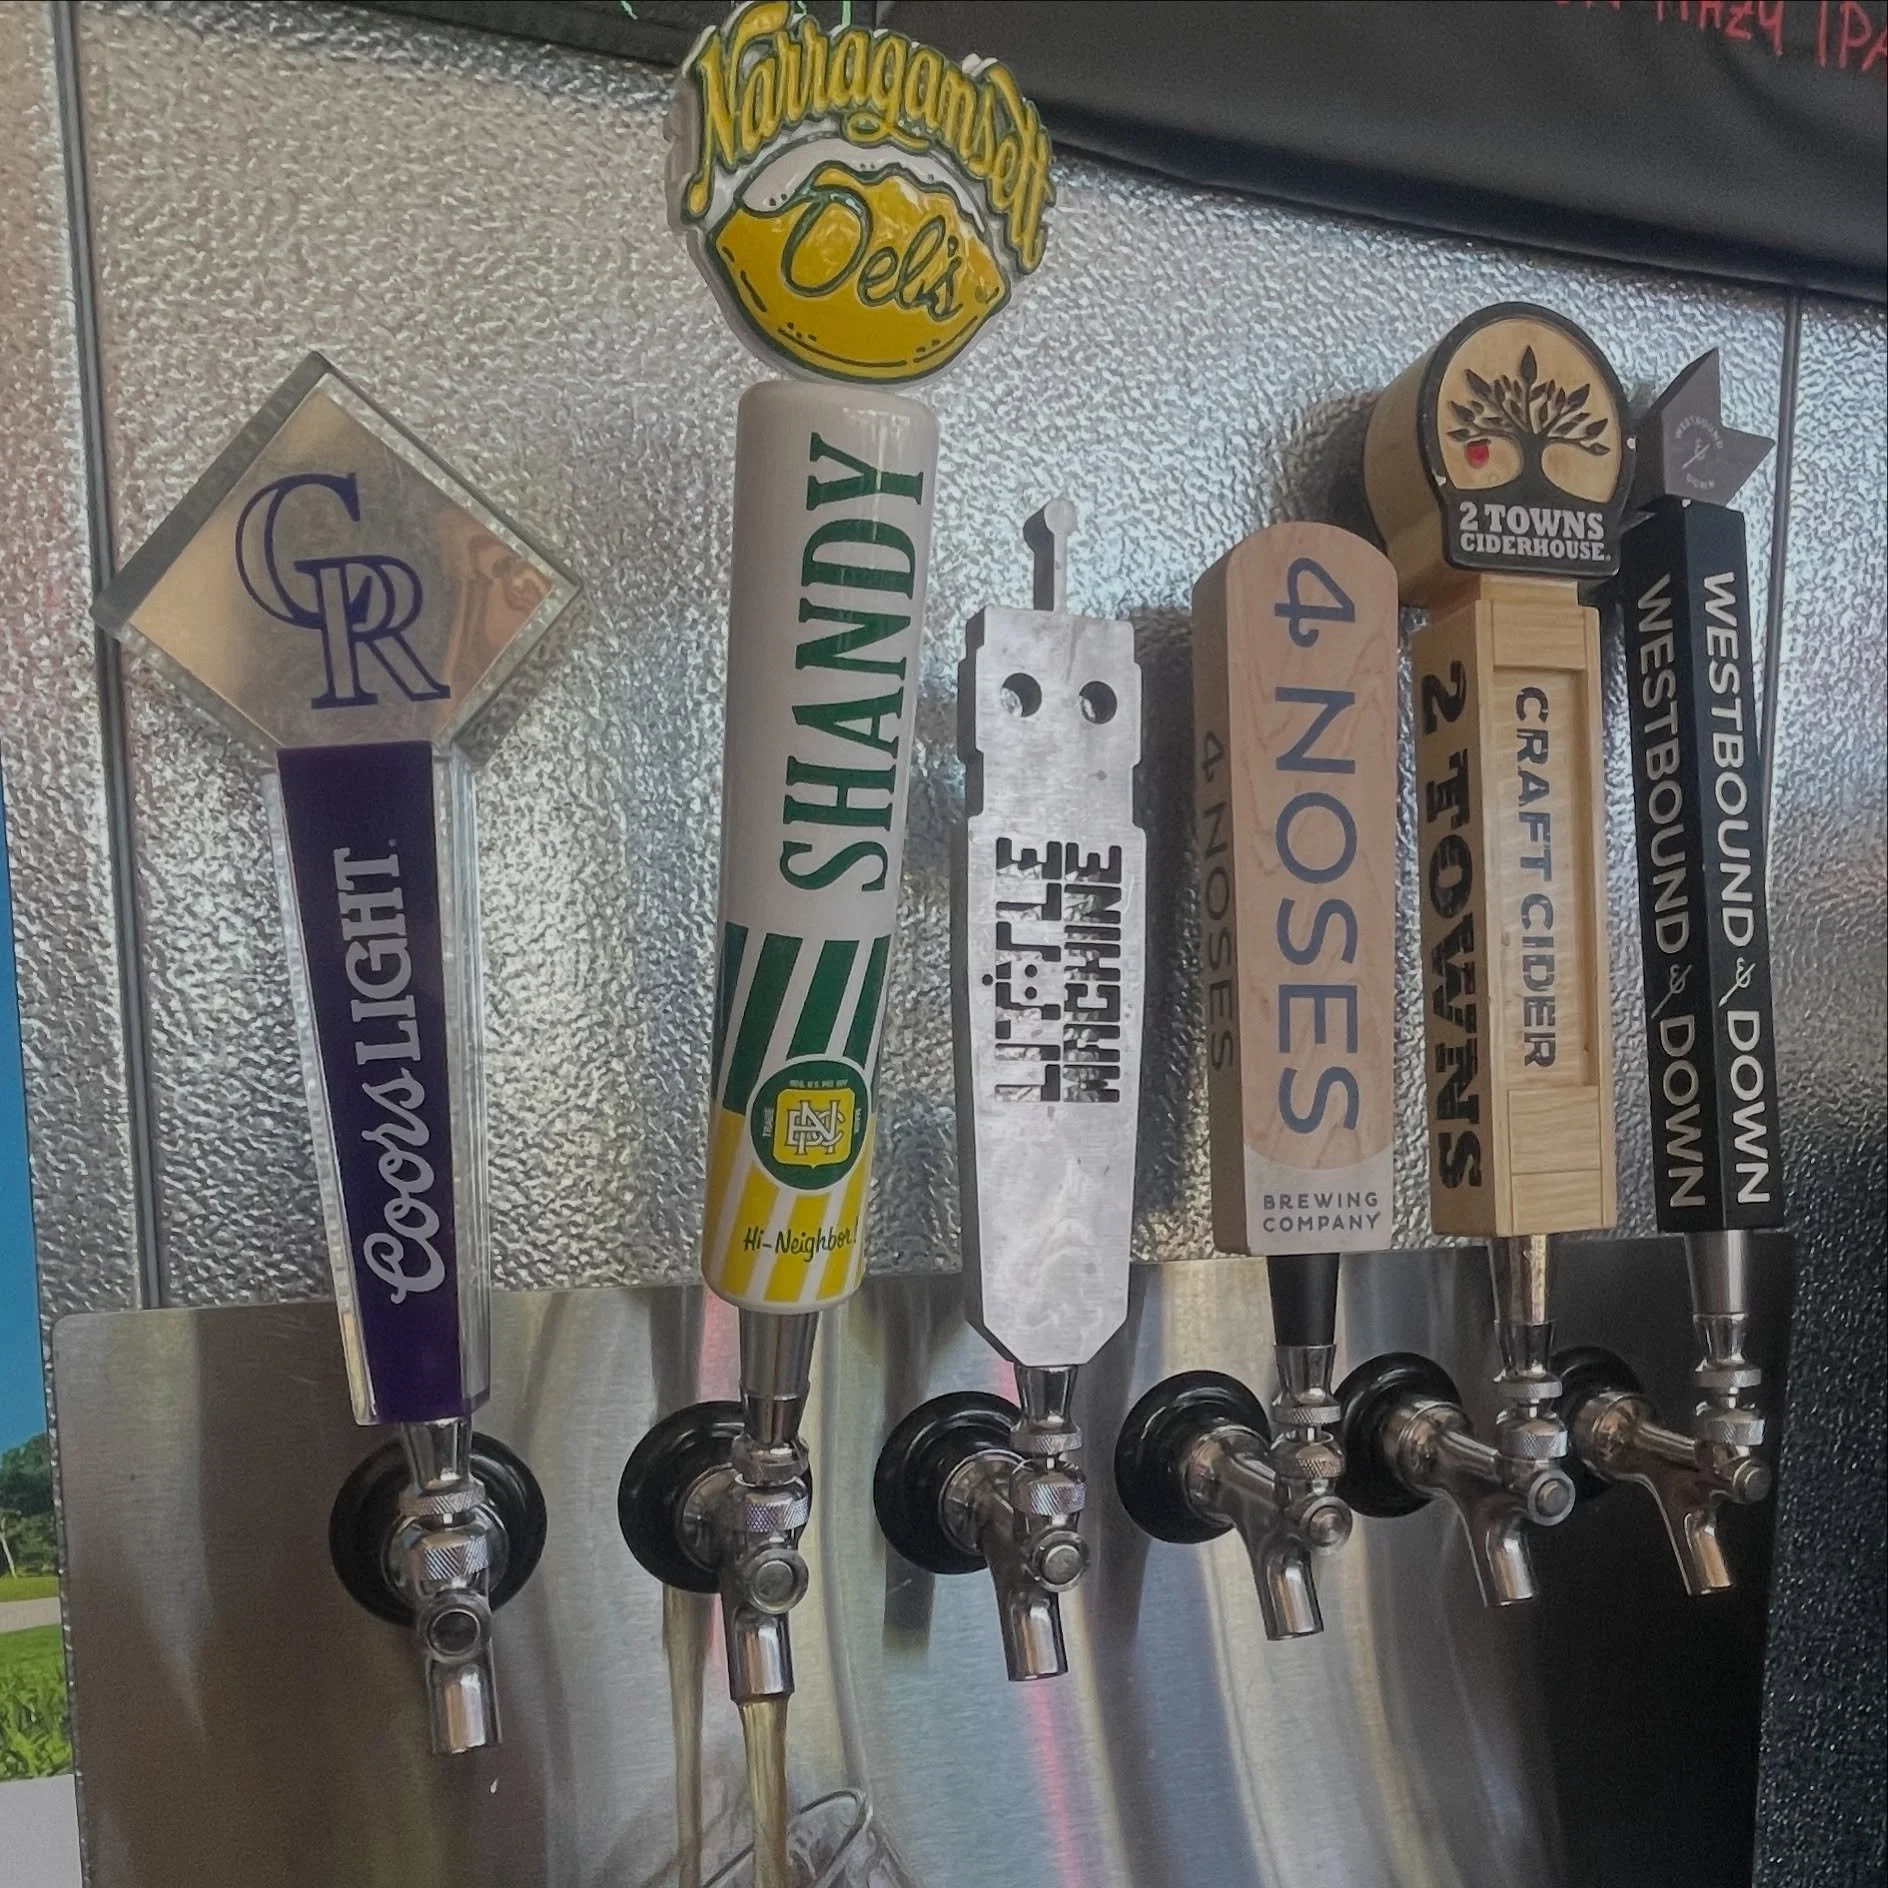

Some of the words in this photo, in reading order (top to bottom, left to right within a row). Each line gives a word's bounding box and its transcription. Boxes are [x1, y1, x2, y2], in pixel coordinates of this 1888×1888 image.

[1274, 557, 1355, 648] 4
[1459, 502, 1477, 532] 2
[1484, 504, 1605, 540] TOWNS
[1460, 532, 1605, 561] CIDERHOUSE
[779, 432, 924, 892] SHANDY
[1202, 730, 1223, 784] 4
[1421, 660, 1467, 735] 2
[1704, 572, 1754, 948] WESTBOUND
[1515, 686, 1552, 882] CRAFT
[1638, 574, 1689, 954] WESTBOUND
[333, 846, 421, 1066] LIGHT
[1062, 841, 1122, 1103] MACHINE
[1203, 799, 1233, 1072] NOSES
[1274, 686, 1359, 1134] NOSES
[1426, 747, 1482, 1189] TOWNS
[1519, 892, 1556, 1070] CIDER
[362, 1067, 446, 1305] Coors
[1263, 1191, 1378, 1210] BREWING
[1659, 1013, 1706, 1208] DOWN
[1726, 1009, 1770, 1205] DOWN
[1263, 1211, 1381, 1233] COMPANY
